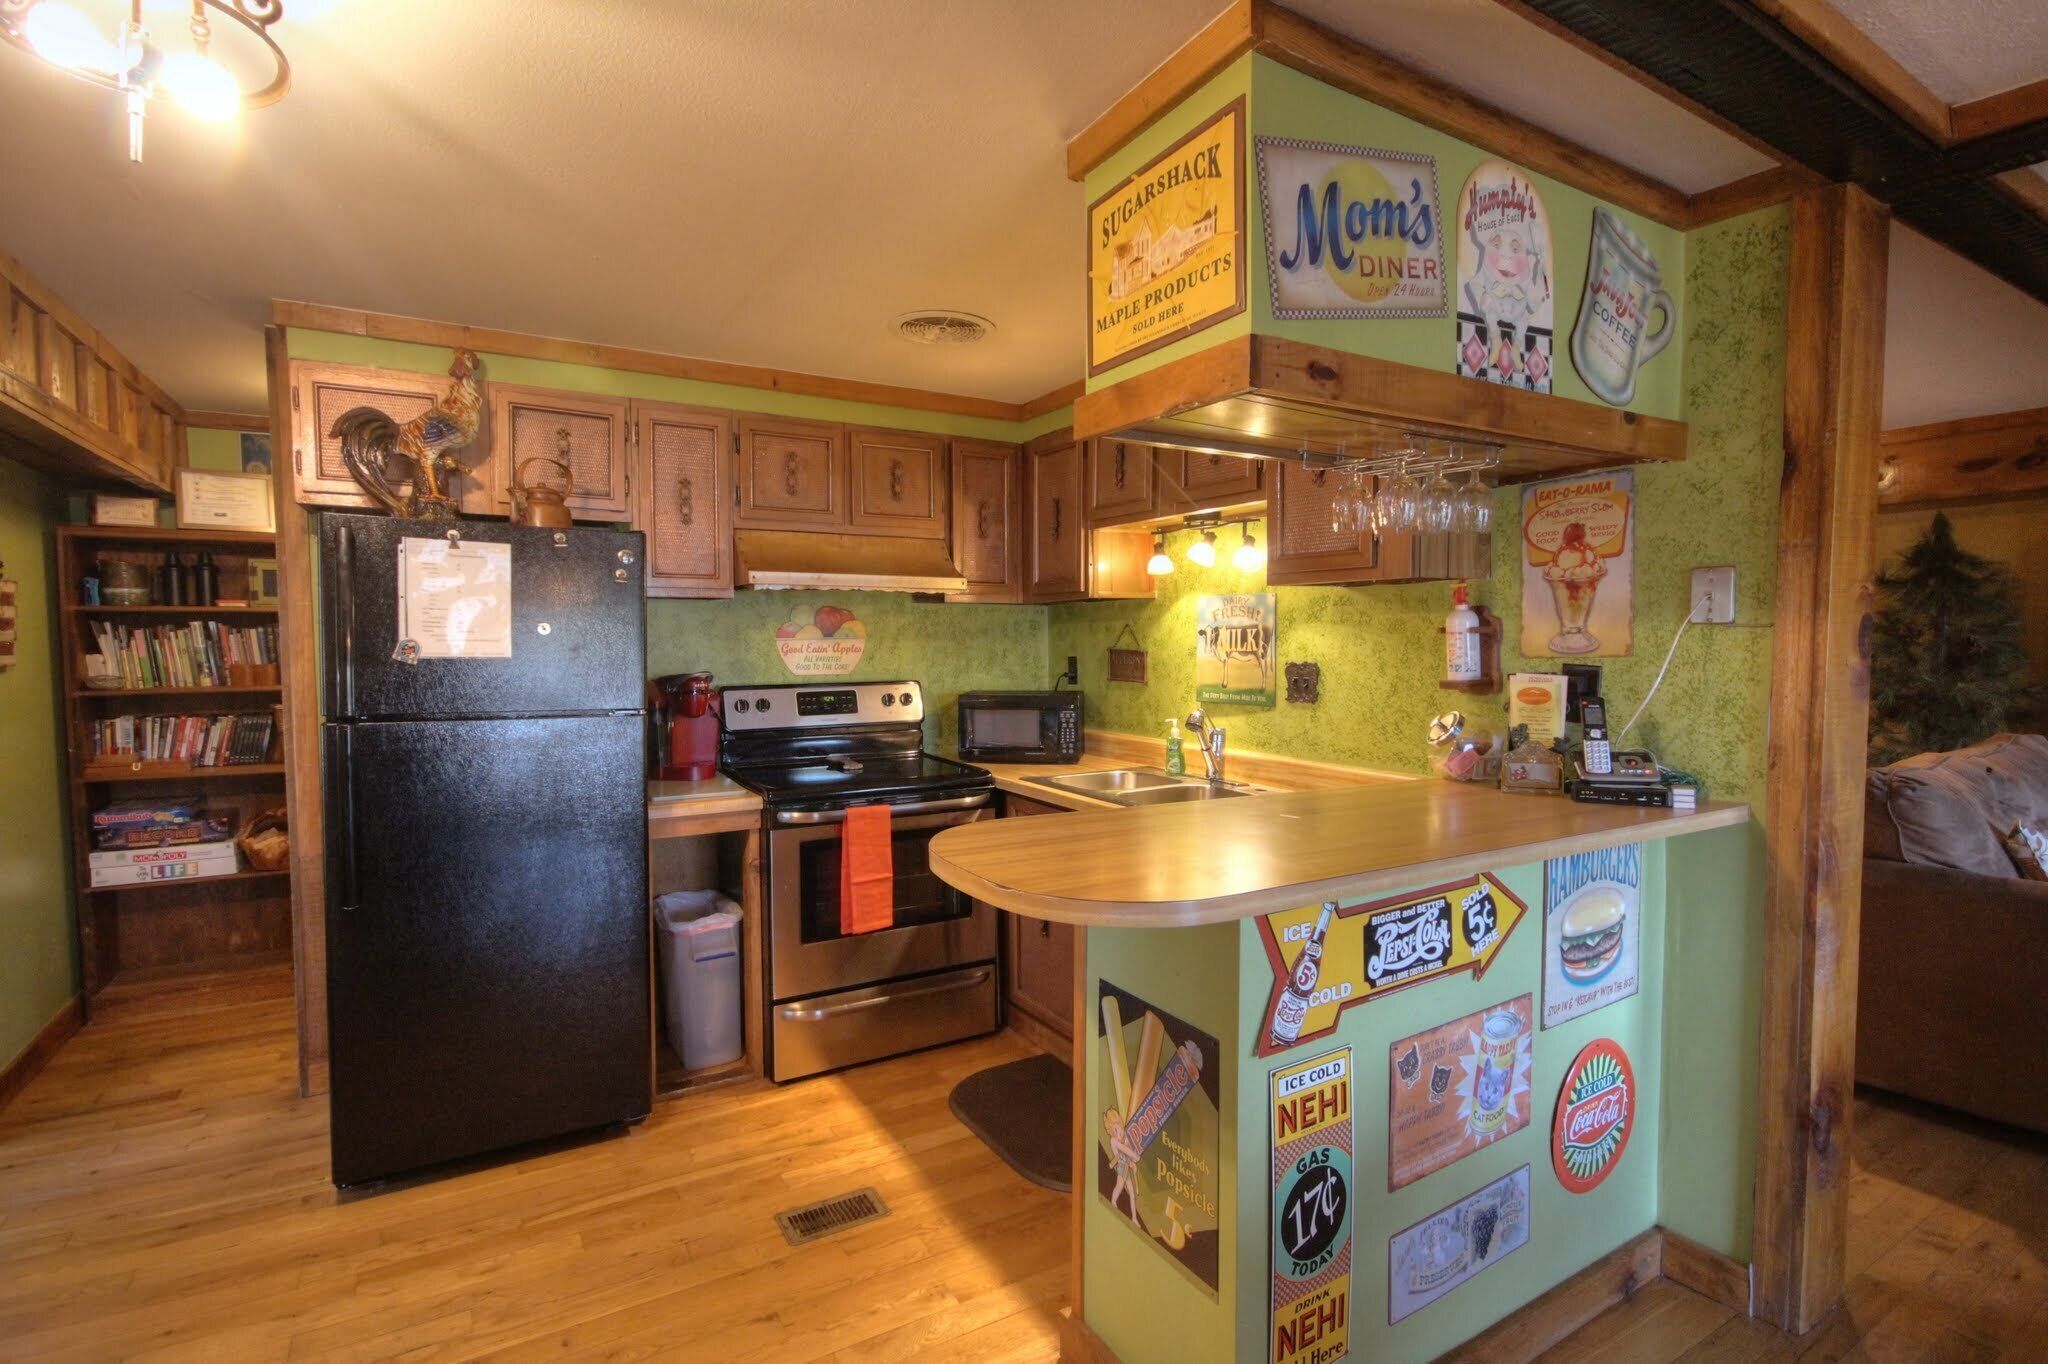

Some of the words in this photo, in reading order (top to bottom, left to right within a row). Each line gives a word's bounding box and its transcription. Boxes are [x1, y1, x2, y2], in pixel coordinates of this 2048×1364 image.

[1102, 143, 1222, 249] SUGARSHACK
[1280, 178, 1433, 271] Mom's
[1359, 254, 1439, 280] DINER
[1096, 299, 1141, 334] MAPLE
[1144, 252, 1232, 310] PRODUCTS
[1393, 283, 1407, 297] 24
[1132, 316, 1156, 335] SOLD
[1158, 303, 1185, 323] HERE
[1593, 301, 1638, 348] COFFEE
[1539, 480, 1612, 501] EAT-O-RAMA
[781, 643, 804, 656] Good
[832, 643, 862, 656] Apples
[151, 862, 199, 879] LIFE
[1548, 842, 1639, 915] HAMBURGERS
[1462, 883, 1490, 910] SOLD
[1371, 910, 1401, 926] BIGGER
[1402, 906, 1416, 917] and
[1416, 899, 1446, 913] BETTER
[1468, 900, 1495, 942] 5¢
[1283, 922, 1312, 943] ICE
[1471, 927, 1500, 957] HERE
[1308, 982, 1352, 1008] COLD
[1285, 1074, 1306, 1092] ICE
[1309, 1062, 1341, 1082] COLD
[1581, 1083, 1593, 1099] ICE
[1594, 1075, 1613, 1092] COLD
[1278, 1081, 1347, 1139] NEHI
[1473, 1110, 1484, 1123] CAT
[1485, 1106, 1505, 1122] FOOD
[1162, 1131, 1210, 1176] Everybody
[1172, 1153, 1197, 1184] likes
[1297, 1147, 1330, 1175] GAS
[1288, 1168, 1341, 1255] 17¢
[1291, 1243, 1334, 1277] TODAY
[1295, 1288, 1331, 1314] DRINK
[1277, 1292, 1345, 1362] NEHI
[1311, 1341, 1344, 1364] Here
